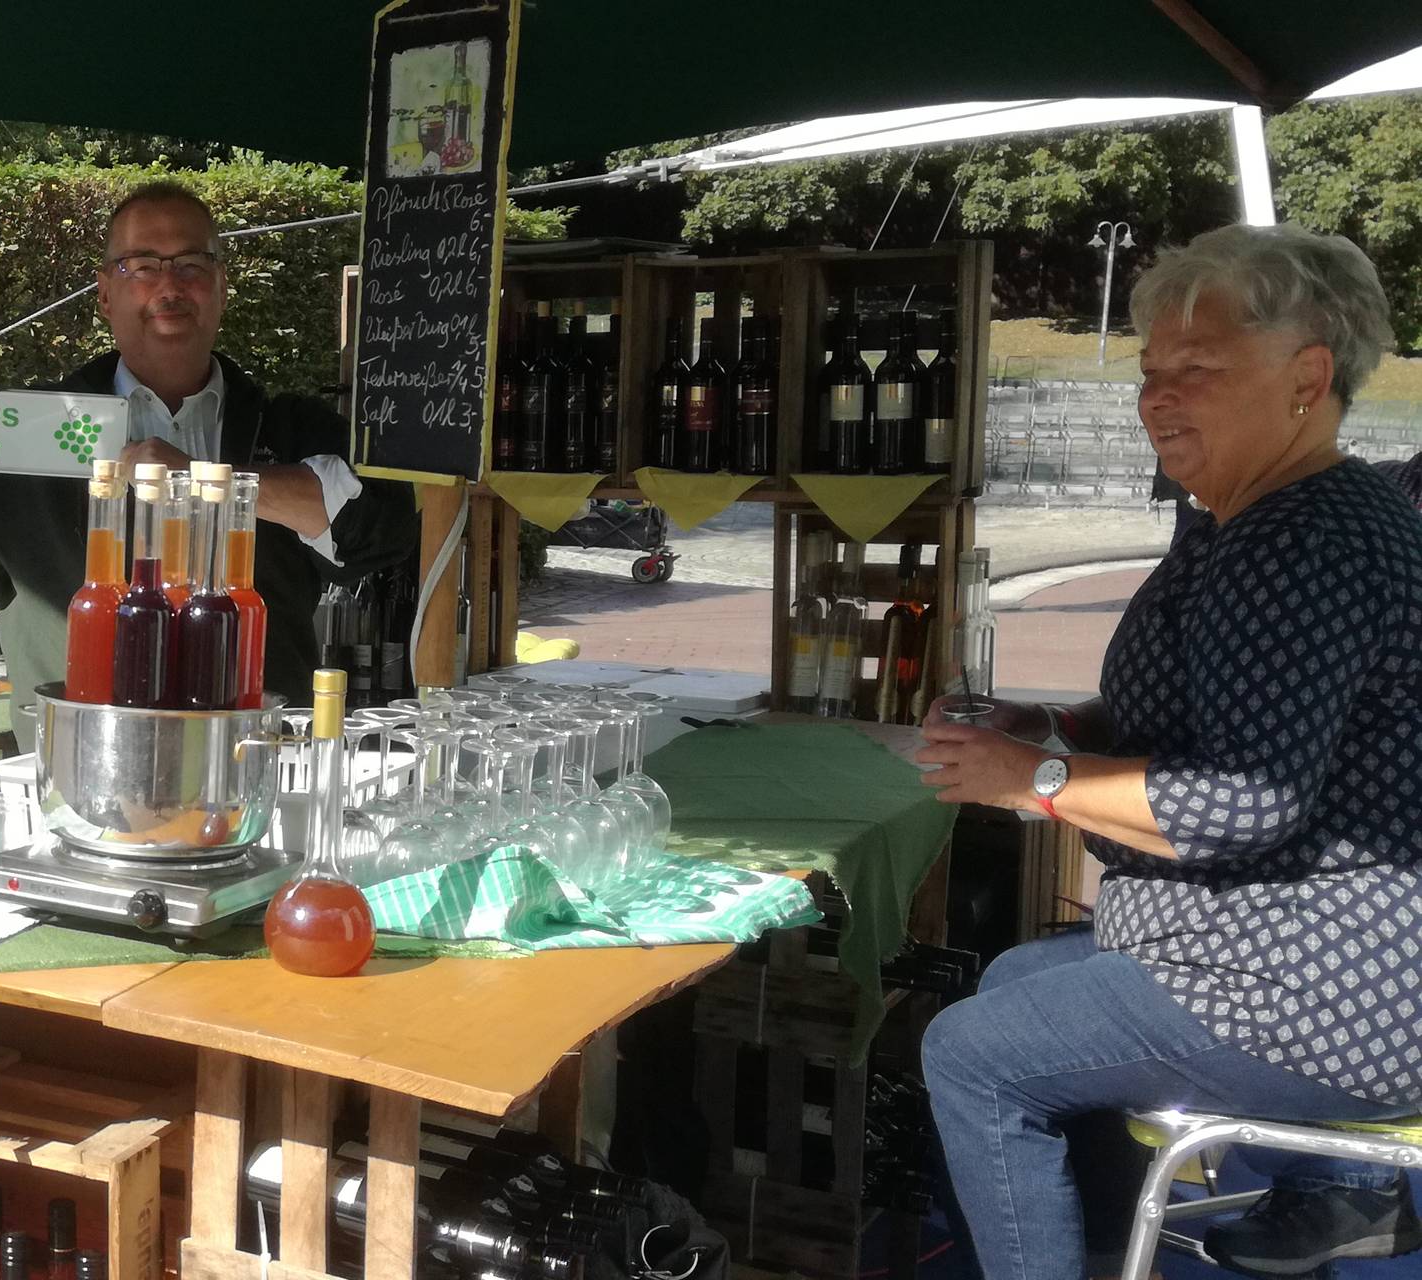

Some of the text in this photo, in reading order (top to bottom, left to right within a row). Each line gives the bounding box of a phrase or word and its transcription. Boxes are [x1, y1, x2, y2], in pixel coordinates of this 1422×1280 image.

[446, 182, 489, 209] Rosé
[368, 233, 432, 279] Riesling
[366, 279, 406, 305] Rosé
[361, 395, 399, 436] Saft
